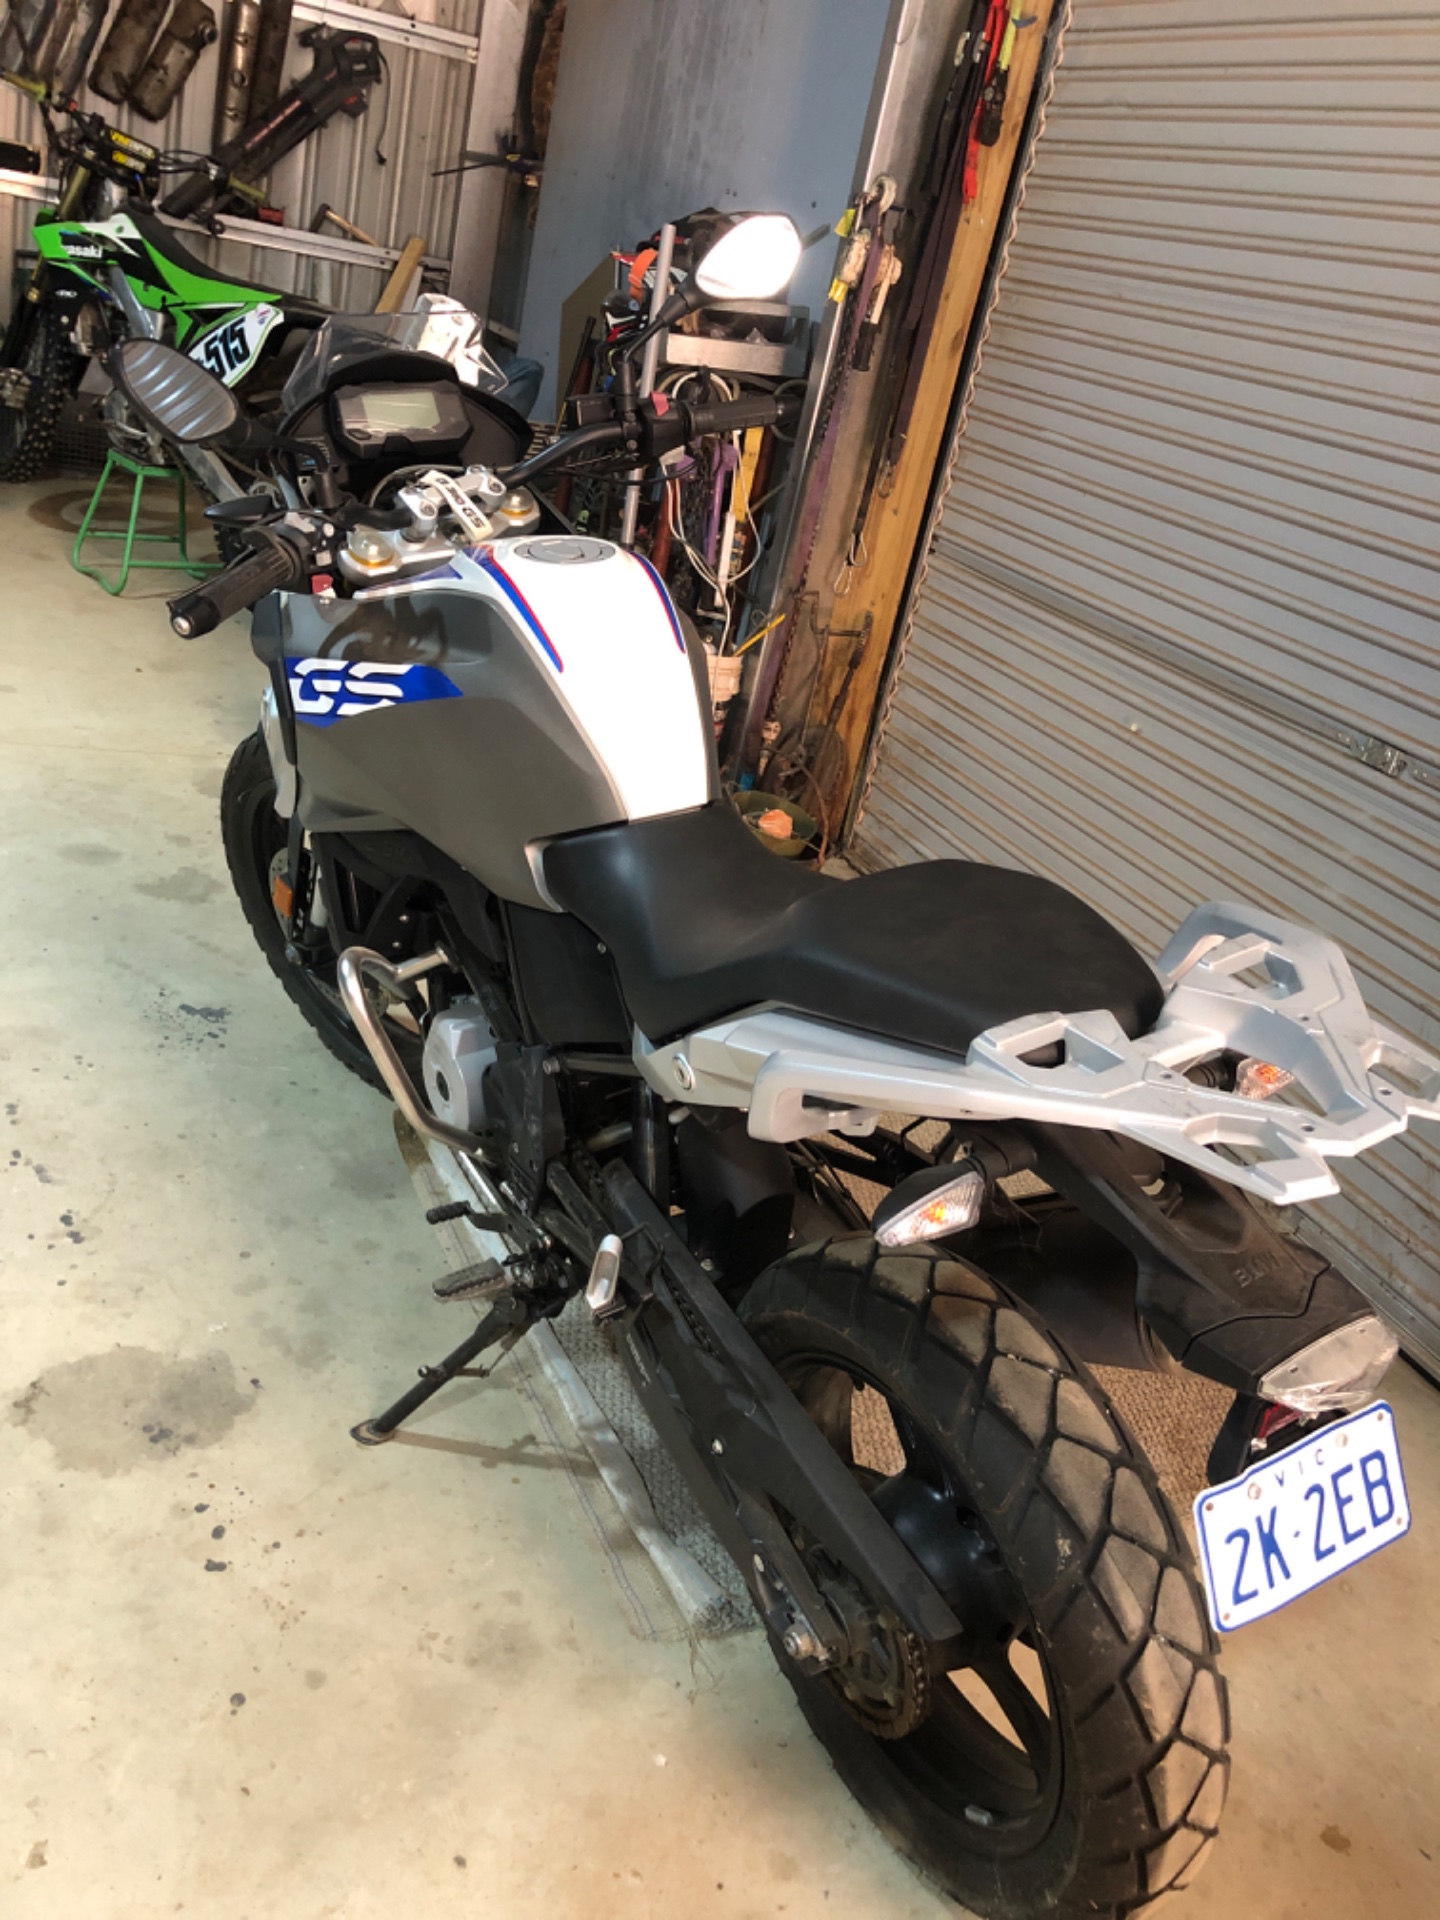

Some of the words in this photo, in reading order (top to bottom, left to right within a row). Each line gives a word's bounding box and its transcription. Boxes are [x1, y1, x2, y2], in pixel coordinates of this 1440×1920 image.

[203, 315, 251, 379] 515
[288, 657, 414, 716] GS
[1275, 1448, 1325, 1487] VIC
